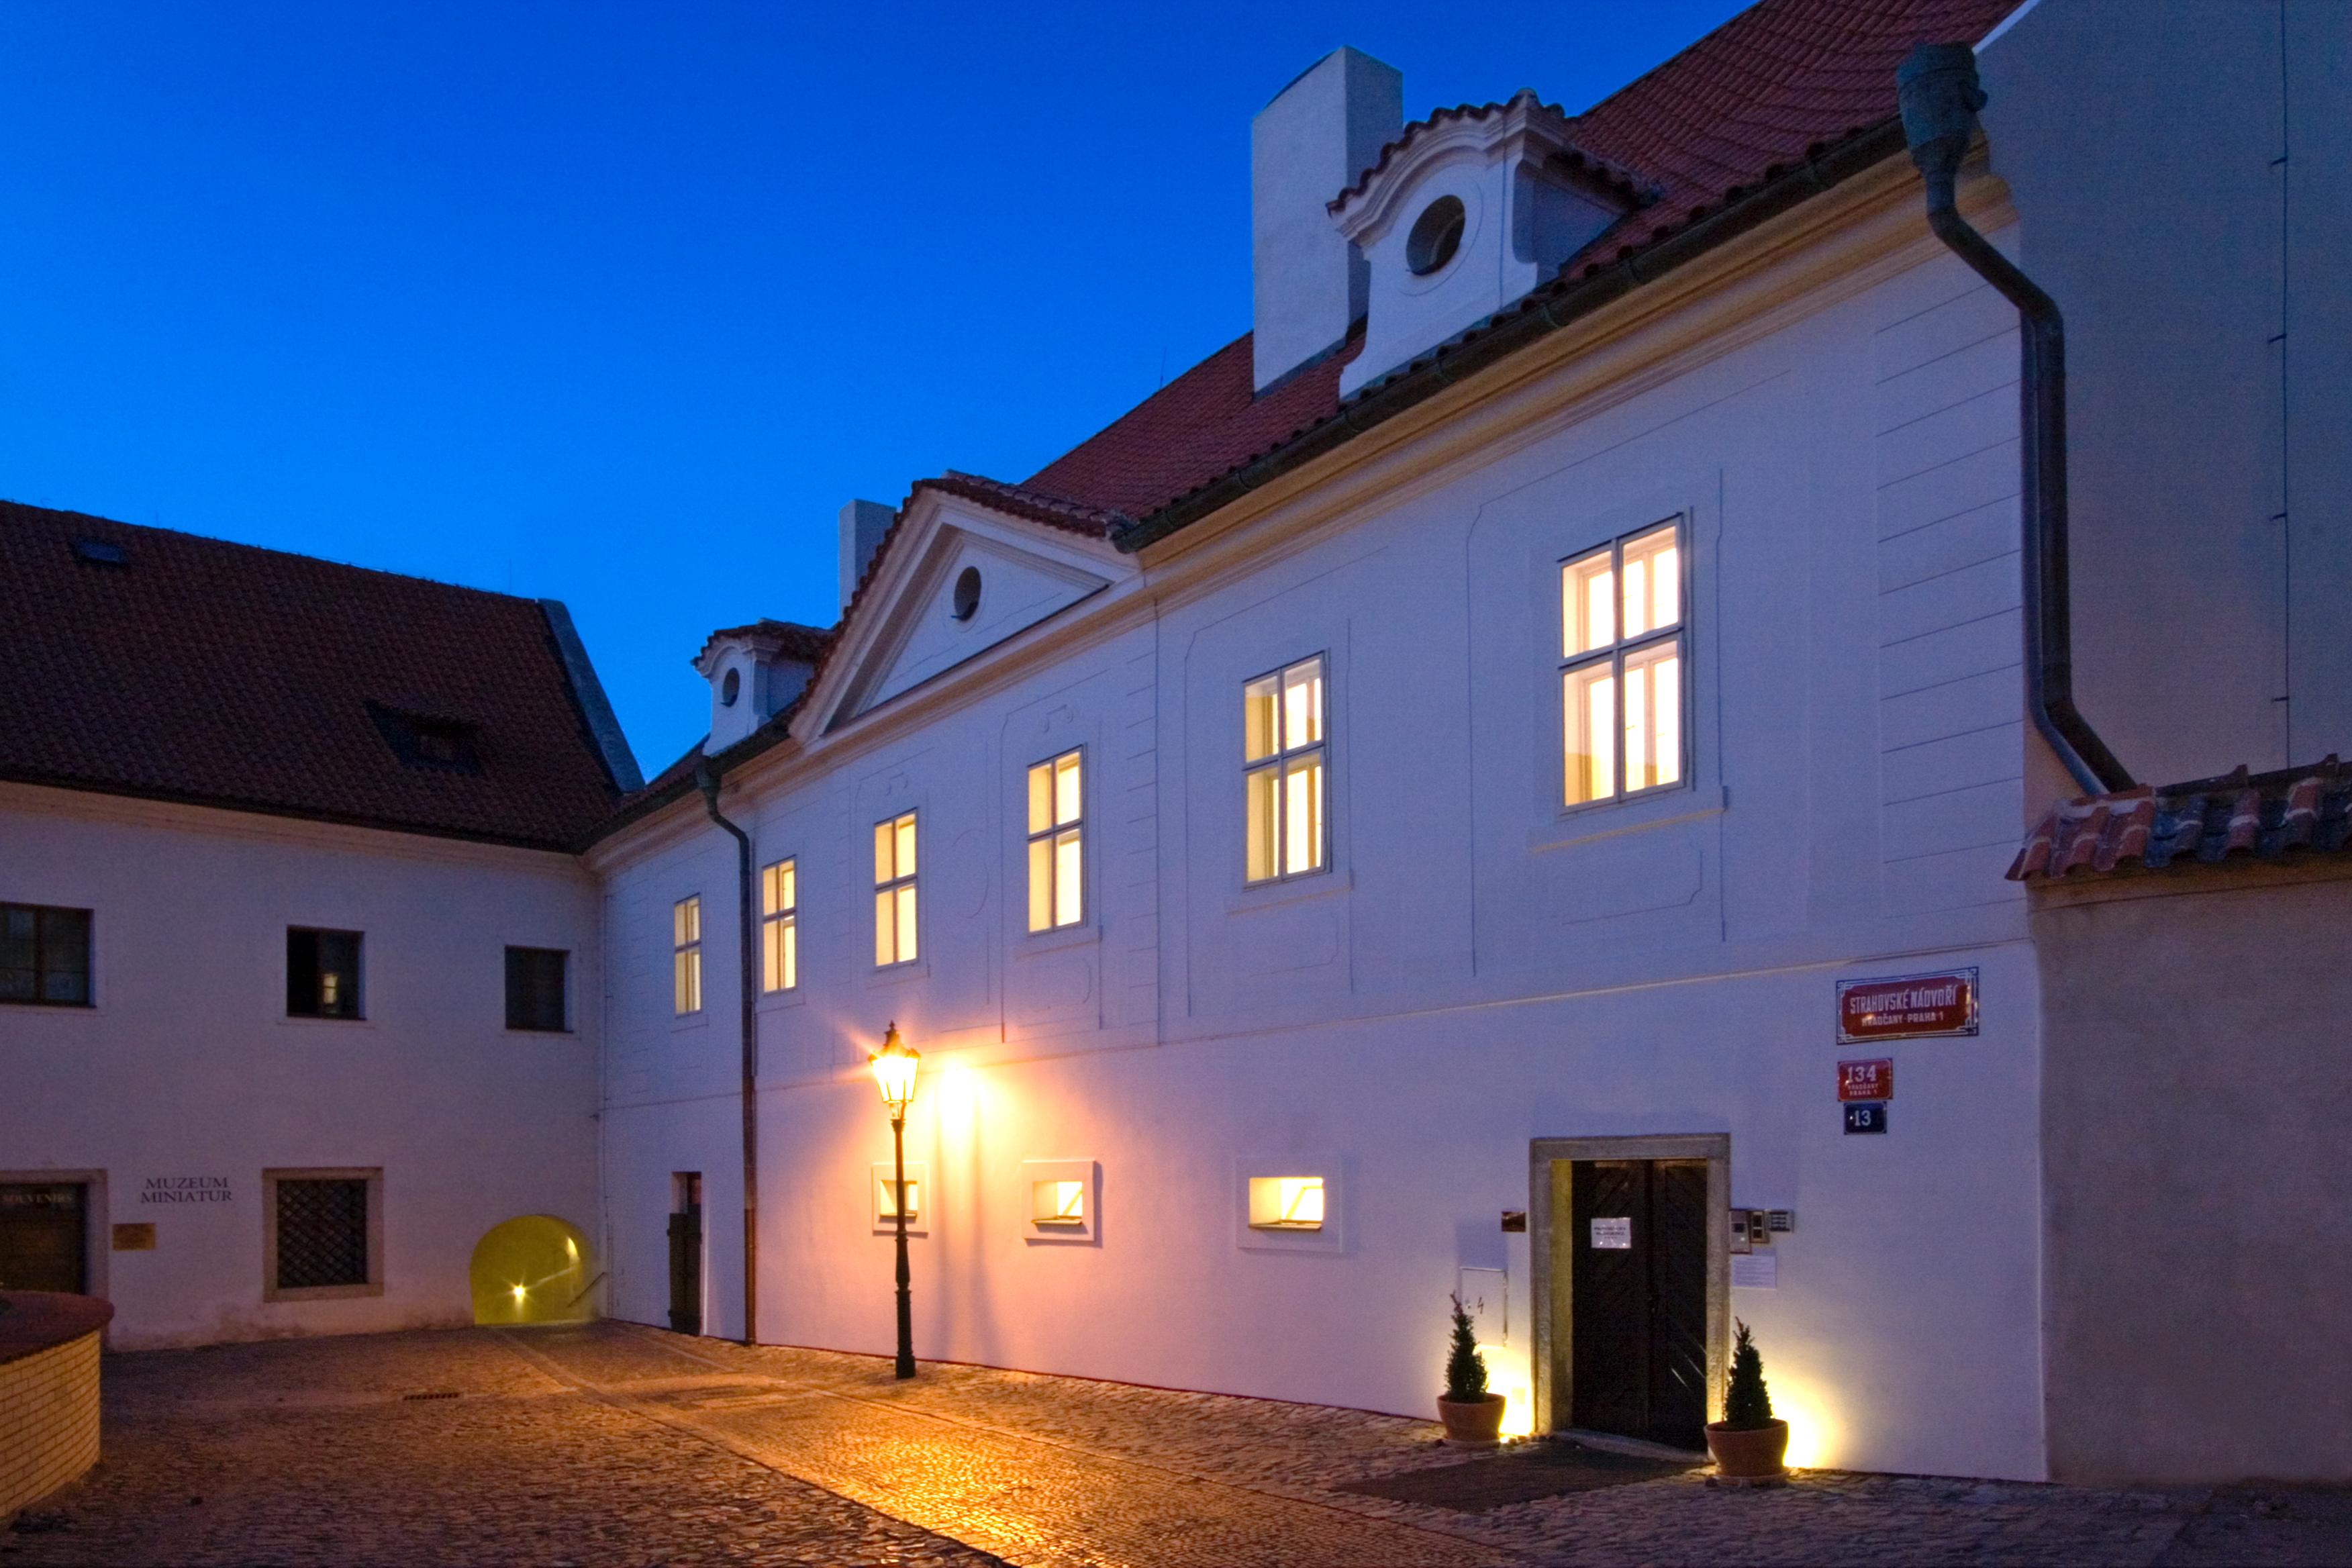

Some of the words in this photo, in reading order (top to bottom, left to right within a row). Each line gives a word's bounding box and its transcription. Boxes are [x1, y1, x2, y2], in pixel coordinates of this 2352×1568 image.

[1850, 989, 1909, 1014] STRAHOVSKÉ
[1910, 985, 1957, 1008] NÁDVOŘÍ
[1939, 1012, 1944, 1020] 1
[1847, 1065, 1877, 1083] 134
[1855, 1110, 1871, 1126] 13
[146, 1177, 228, 1189] MUZEUM
[2, 1193, 74, 1204] SOUVENIRS
[140, 1190, 232, 1204] MINIATUR
